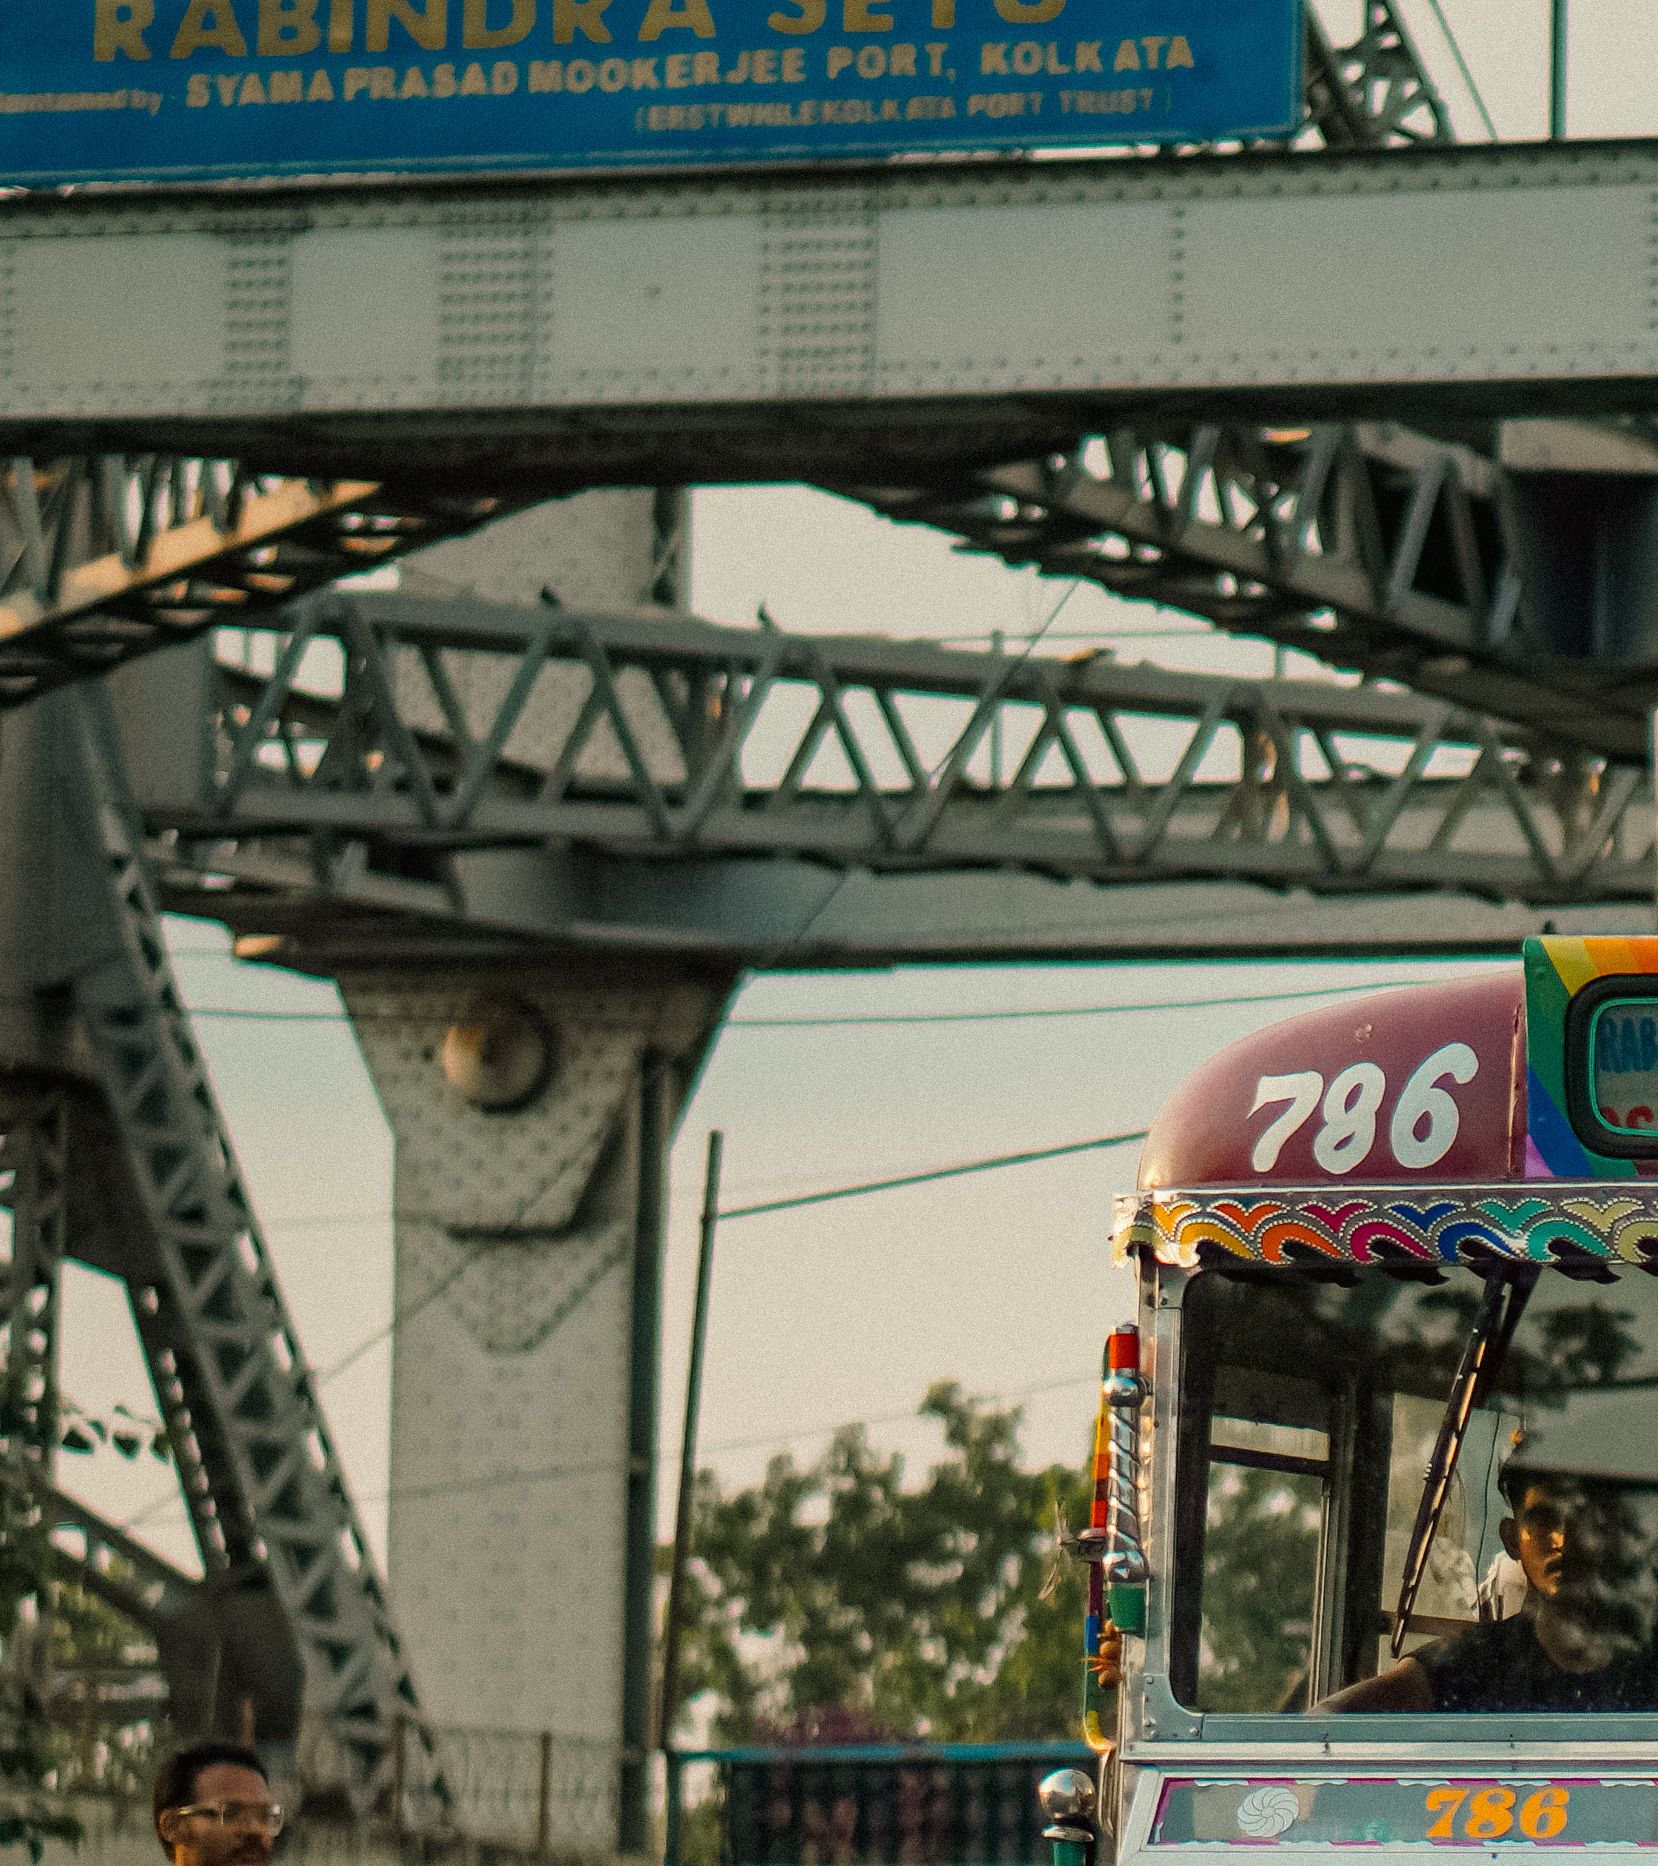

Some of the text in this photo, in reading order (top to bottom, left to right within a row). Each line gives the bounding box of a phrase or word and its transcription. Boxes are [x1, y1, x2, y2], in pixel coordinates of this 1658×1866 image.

[343, 59, 519, 102] PRASAD
[527, 48, 806, 94] MOOKERJEE
[980, 36, 1195, 75] KOLKATA
[1247, 1043, 1480, 1176] 786
[1424, 1785, 1570, 1841] 786
